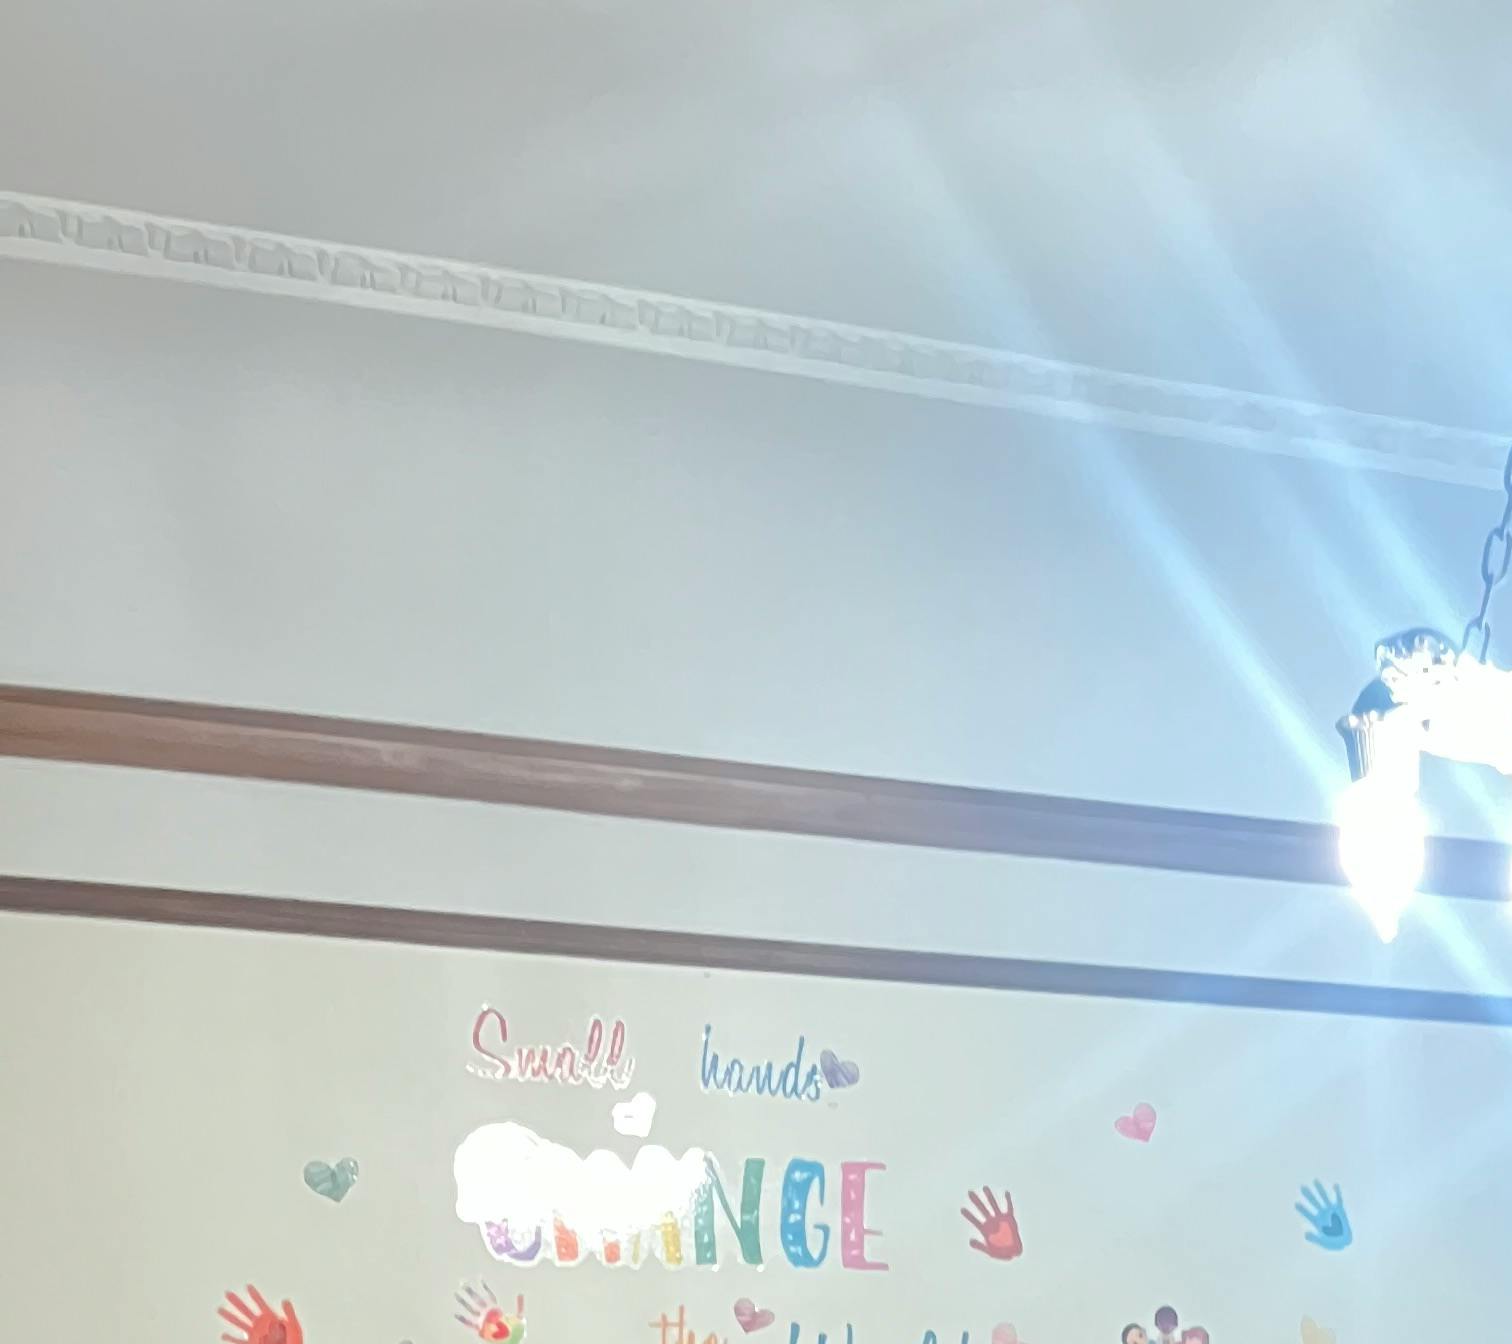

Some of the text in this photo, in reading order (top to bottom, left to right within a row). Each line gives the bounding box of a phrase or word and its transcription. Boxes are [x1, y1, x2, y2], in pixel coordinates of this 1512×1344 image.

[468, 1003, 826, 1101] Small hands
[482, 1147, 890, 1272] NGE
